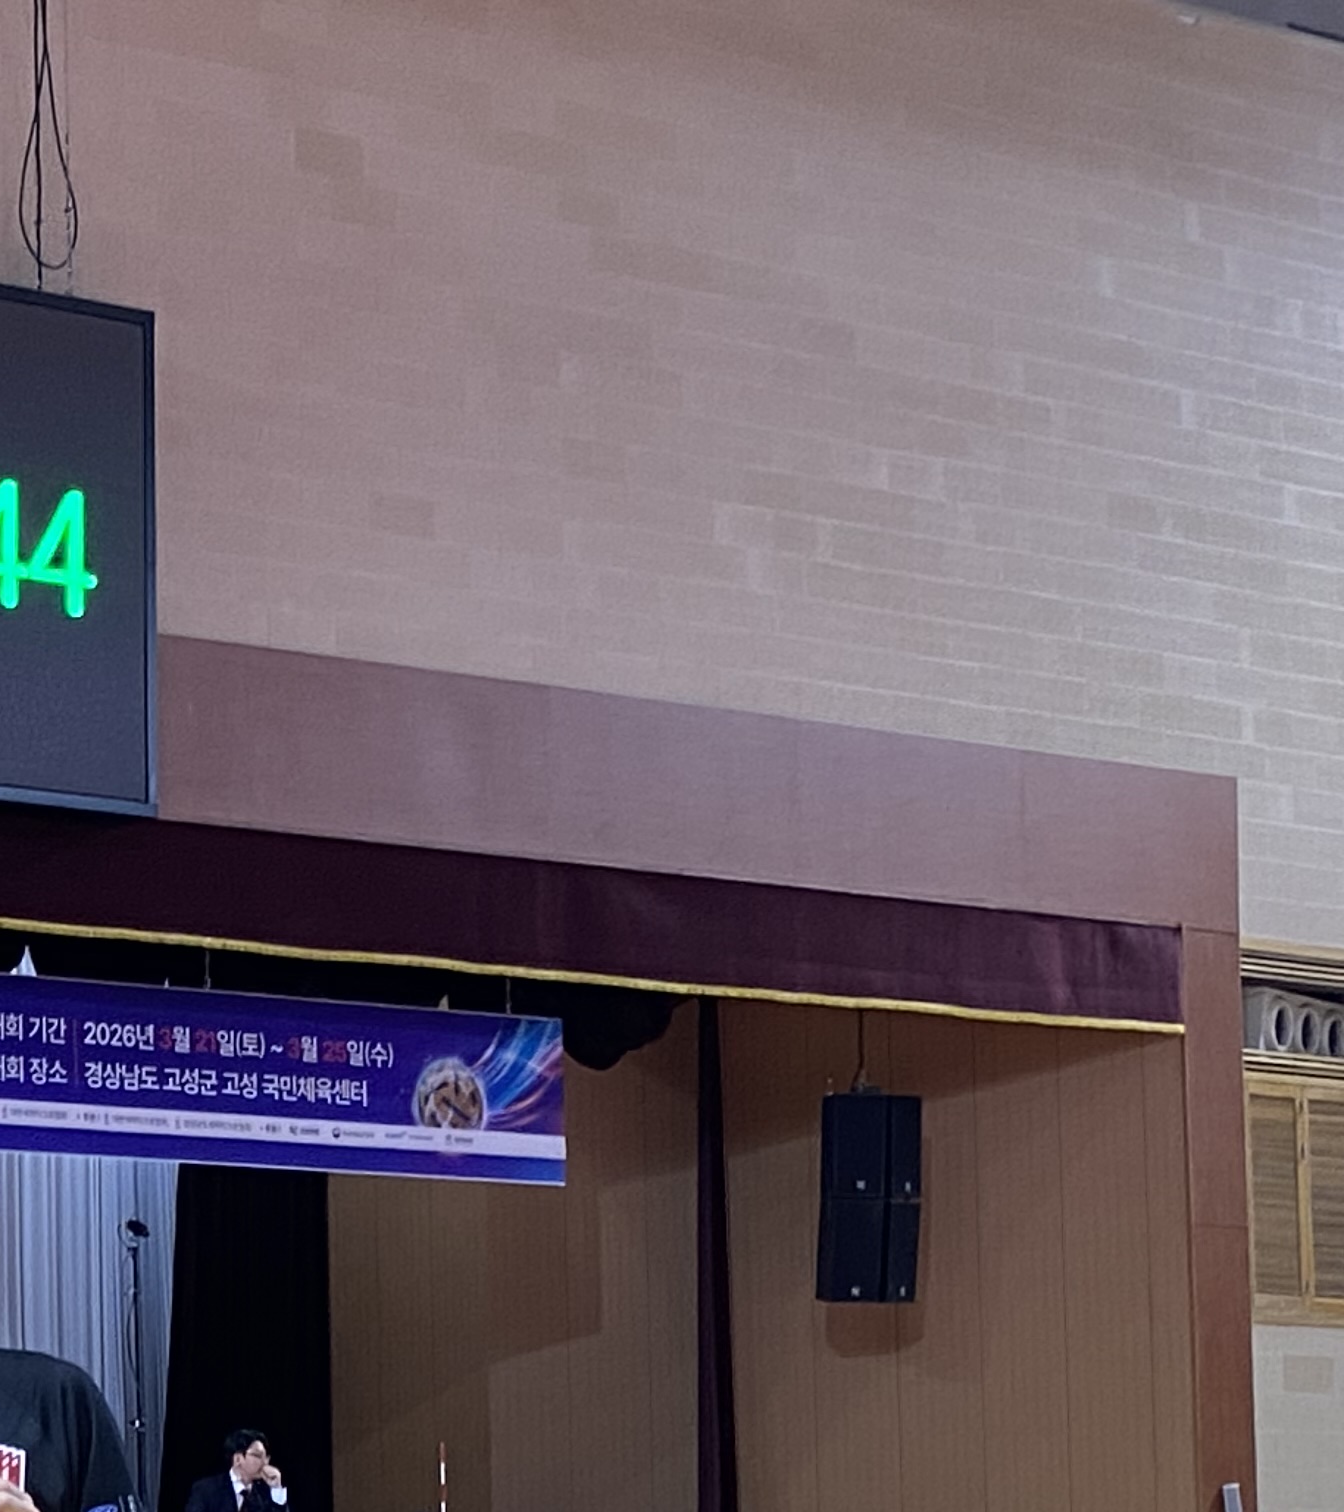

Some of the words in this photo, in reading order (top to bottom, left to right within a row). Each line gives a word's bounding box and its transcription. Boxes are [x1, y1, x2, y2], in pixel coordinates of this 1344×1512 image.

[28, 1017, 67, 1044] 기간
[83, 1021, 155, 1051] 2026년
[29, 1056, 68, 1085] 장소
[83, 1061, 160, 1092] 경상남도
[162, 1067, 218, 1096] 고성군
[222, 1071, 259, 1099] 고성
[262, 1073, 369, 1108] 국민체육센터
